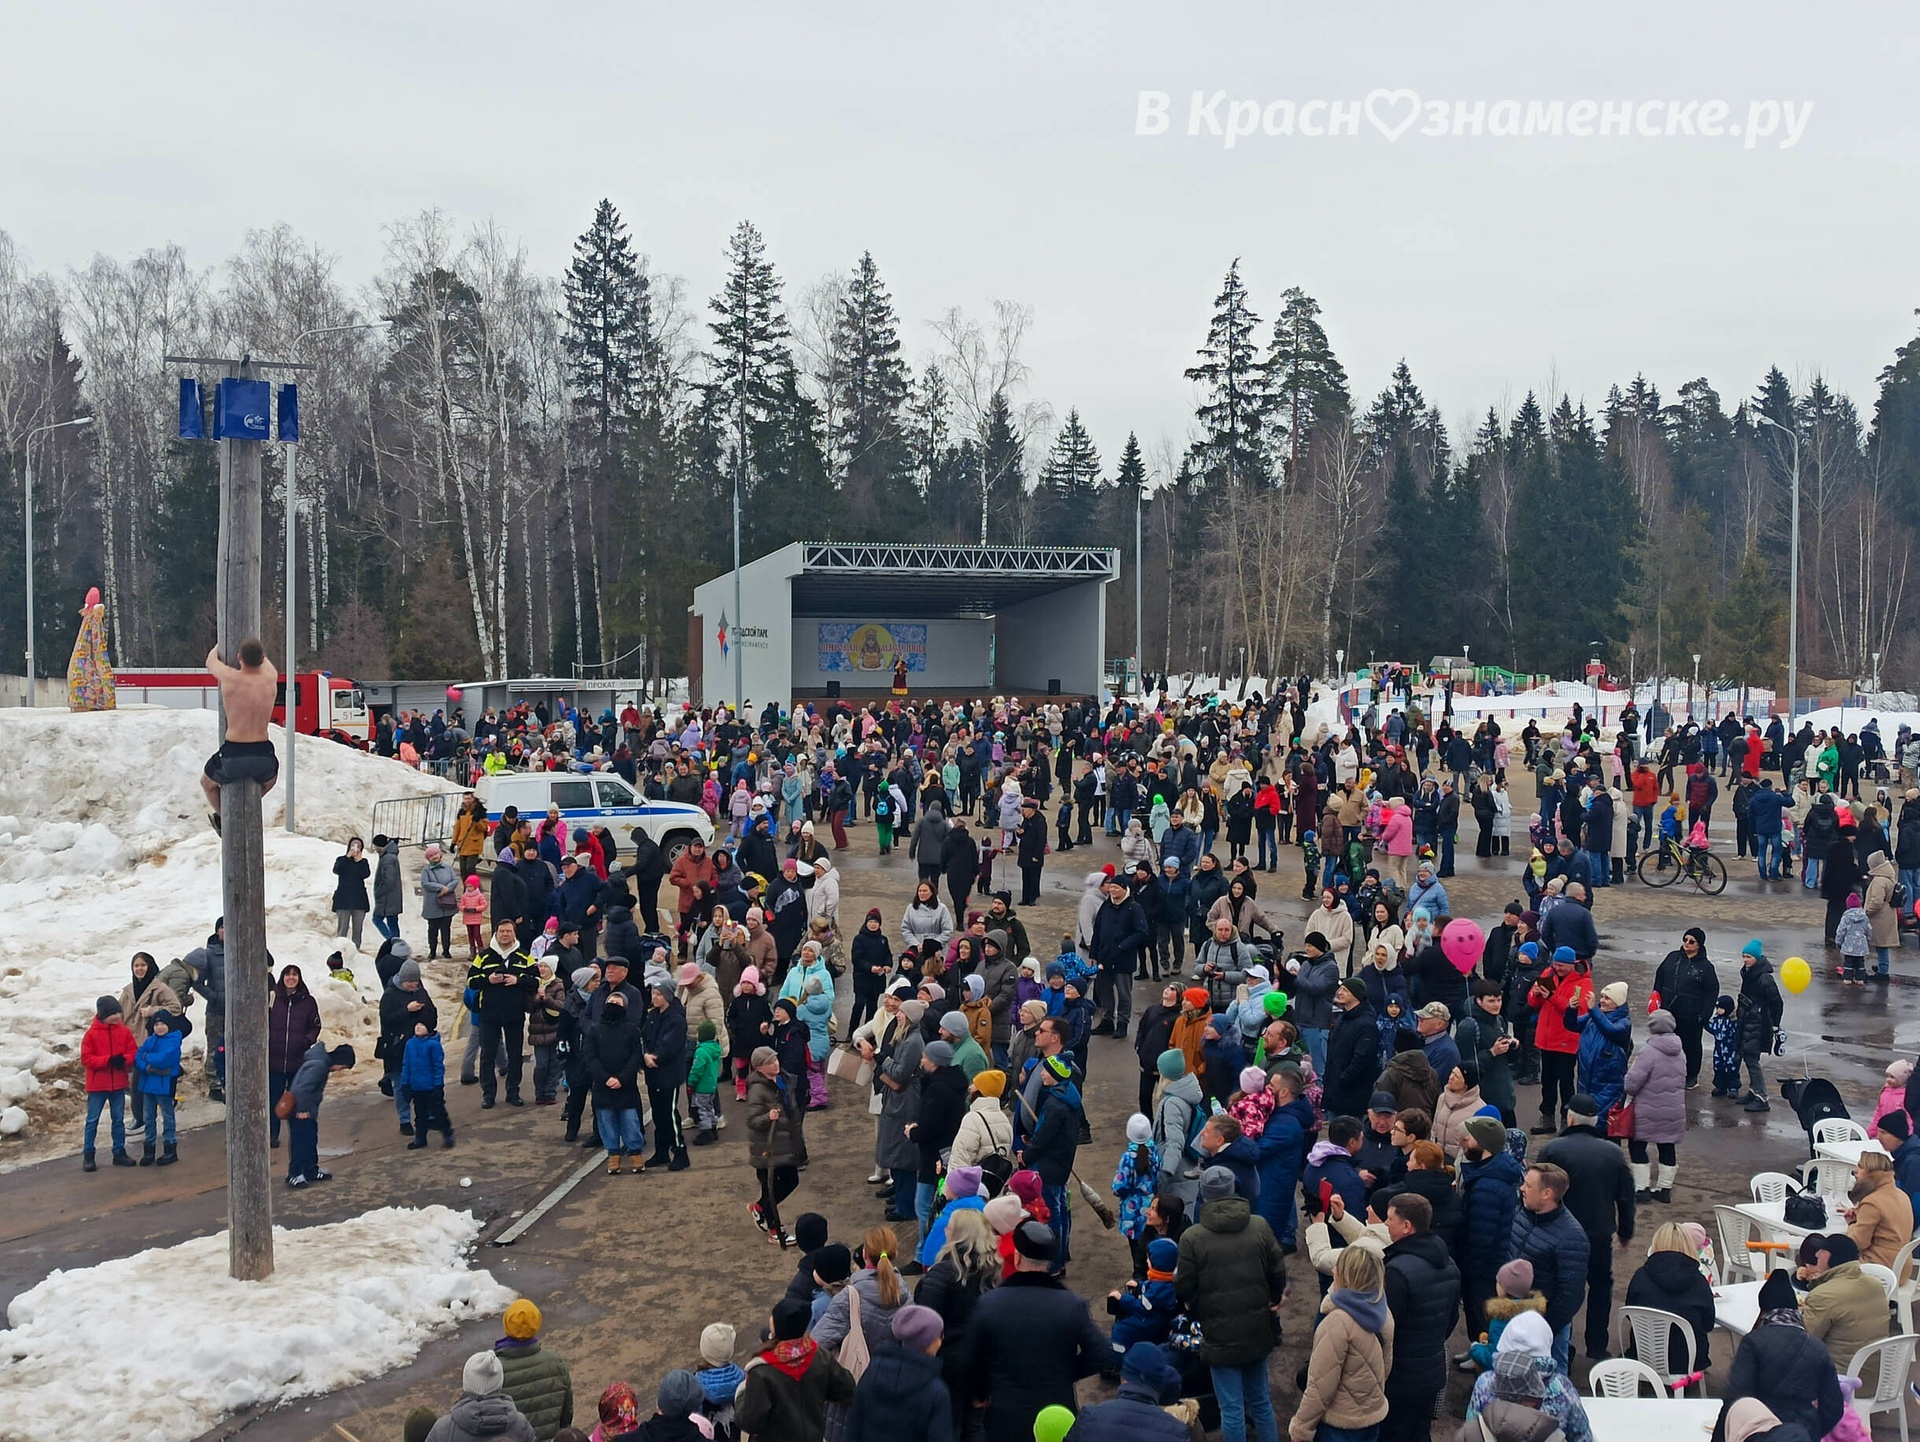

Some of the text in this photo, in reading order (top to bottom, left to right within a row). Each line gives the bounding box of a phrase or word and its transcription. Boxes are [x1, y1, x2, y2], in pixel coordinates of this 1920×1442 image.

[757, 628, 768, 638] ПАРК
[587, 681, 616, 689] ПРОКАТ
[343, 711, 353, 720] 51
